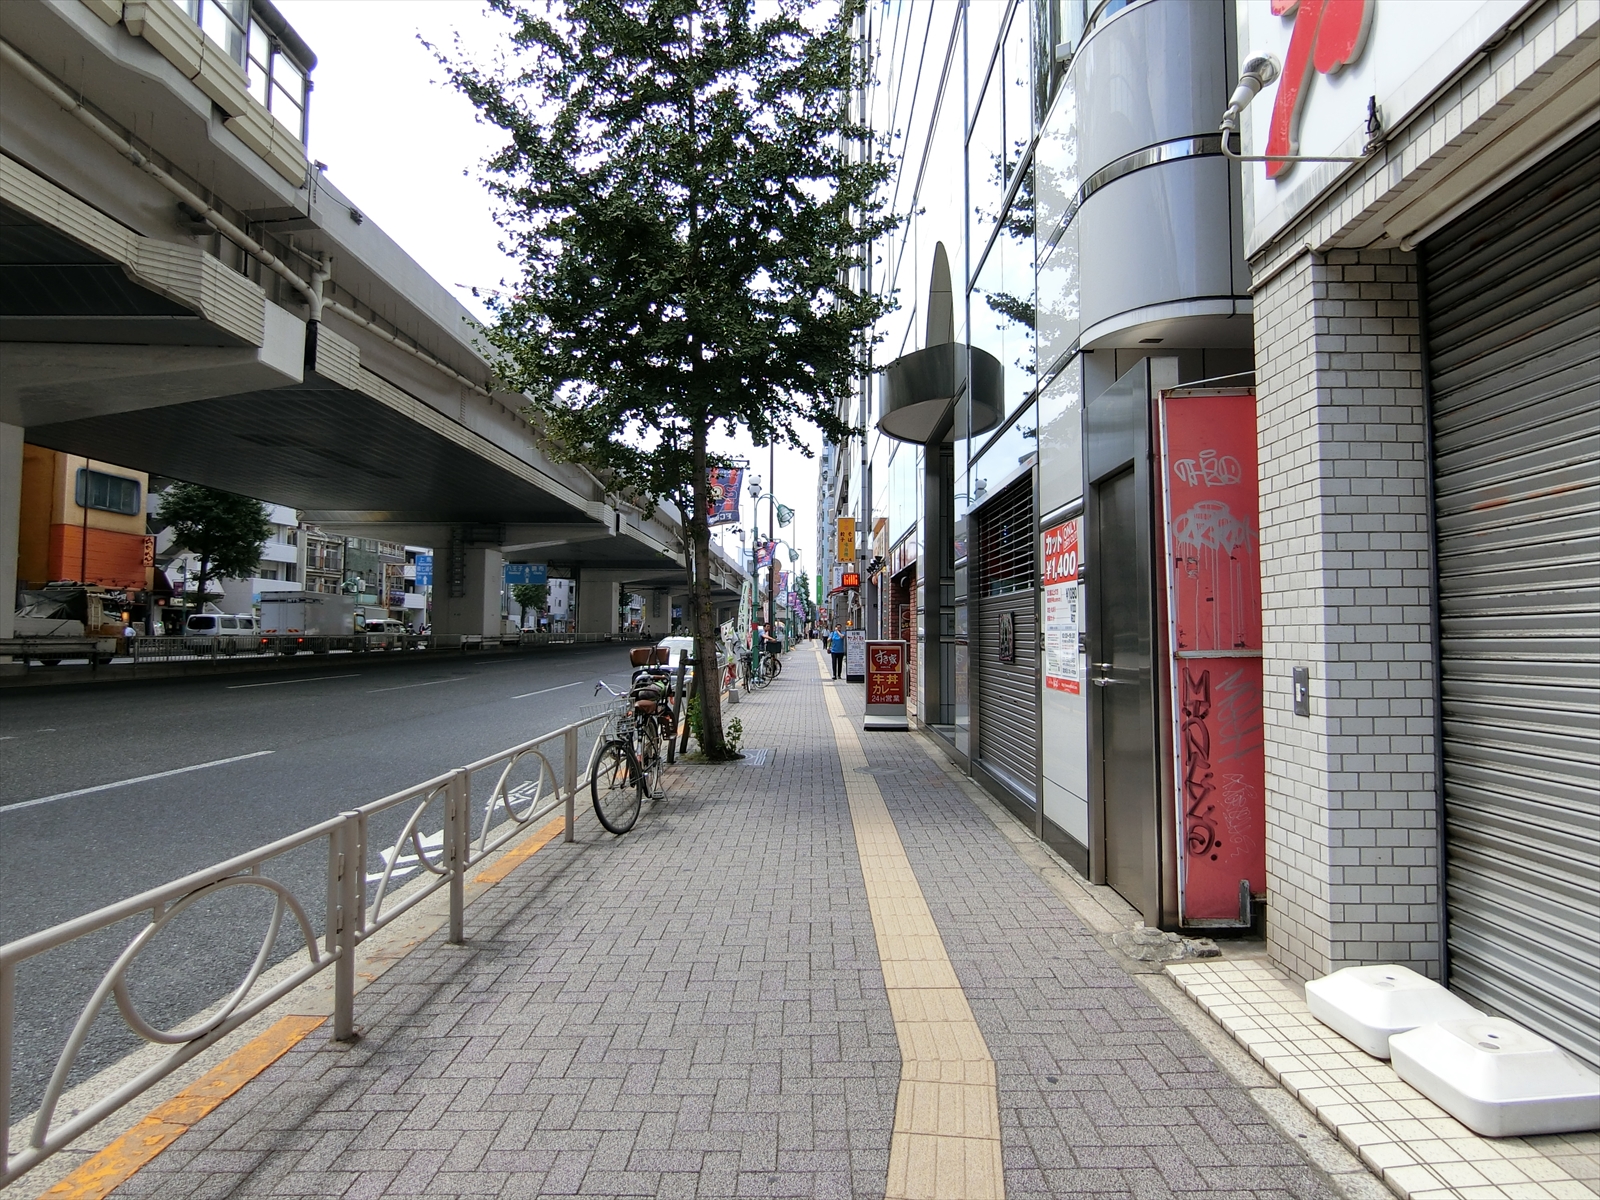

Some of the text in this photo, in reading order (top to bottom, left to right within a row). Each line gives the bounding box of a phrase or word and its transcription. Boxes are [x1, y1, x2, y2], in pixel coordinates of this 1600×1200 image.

[1045, 530, 1063, 556] カット
[1045, 550, 1077, 581] ¥1,400
[874, 649, 898, 665] すき家
[872, 673, 899, 685] 牛丼
[872, 684, 900, 695] カレー
[871, 694, 900, 702] 24H営業
